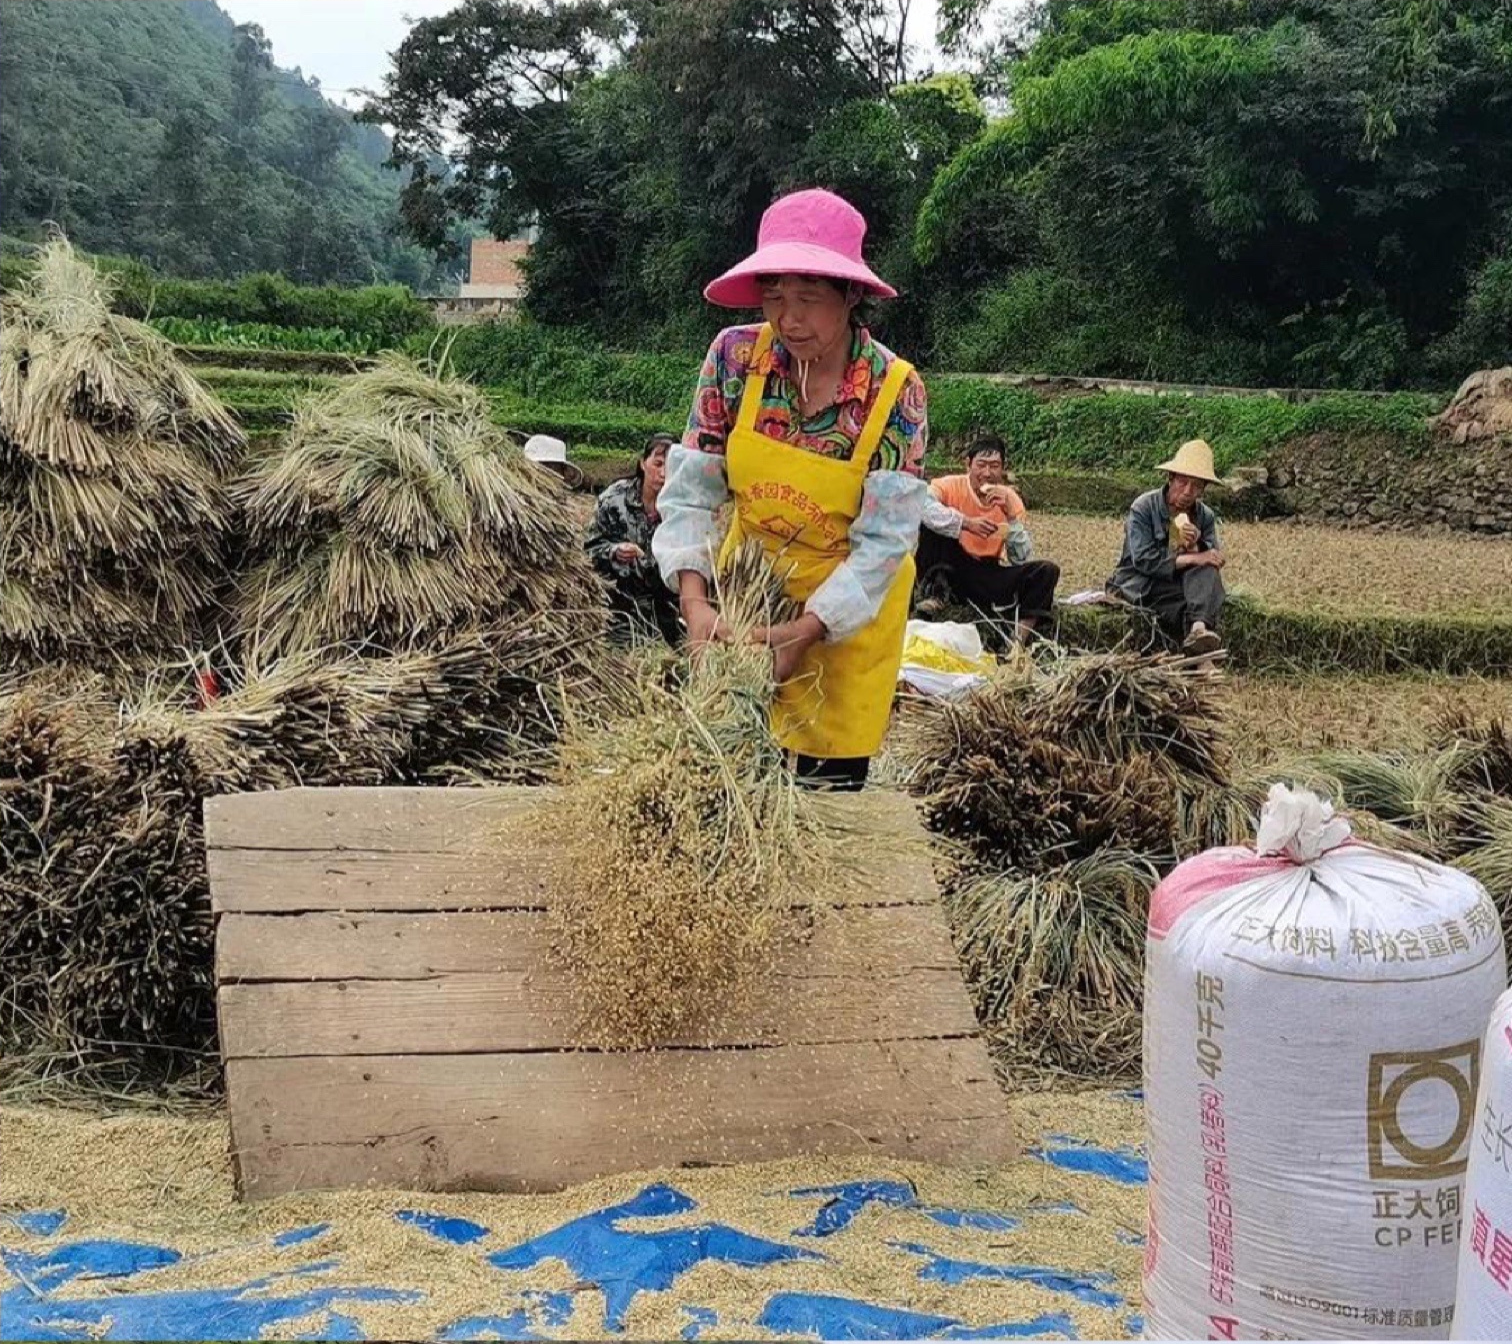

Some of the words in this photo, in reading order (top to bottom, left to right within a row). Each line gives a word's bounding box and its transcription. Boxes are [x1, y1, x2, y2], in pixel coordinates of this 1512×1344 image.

[1231, 915, 1338, 962] 正大饲料
[1350, 919, 1470, 963] 科技含量高
[1196, 970, 1225, 1081] 40千克
[1371, 1185, 1466, 1220] 正大饲
[1374, 1226, 1412, 1248] CP
